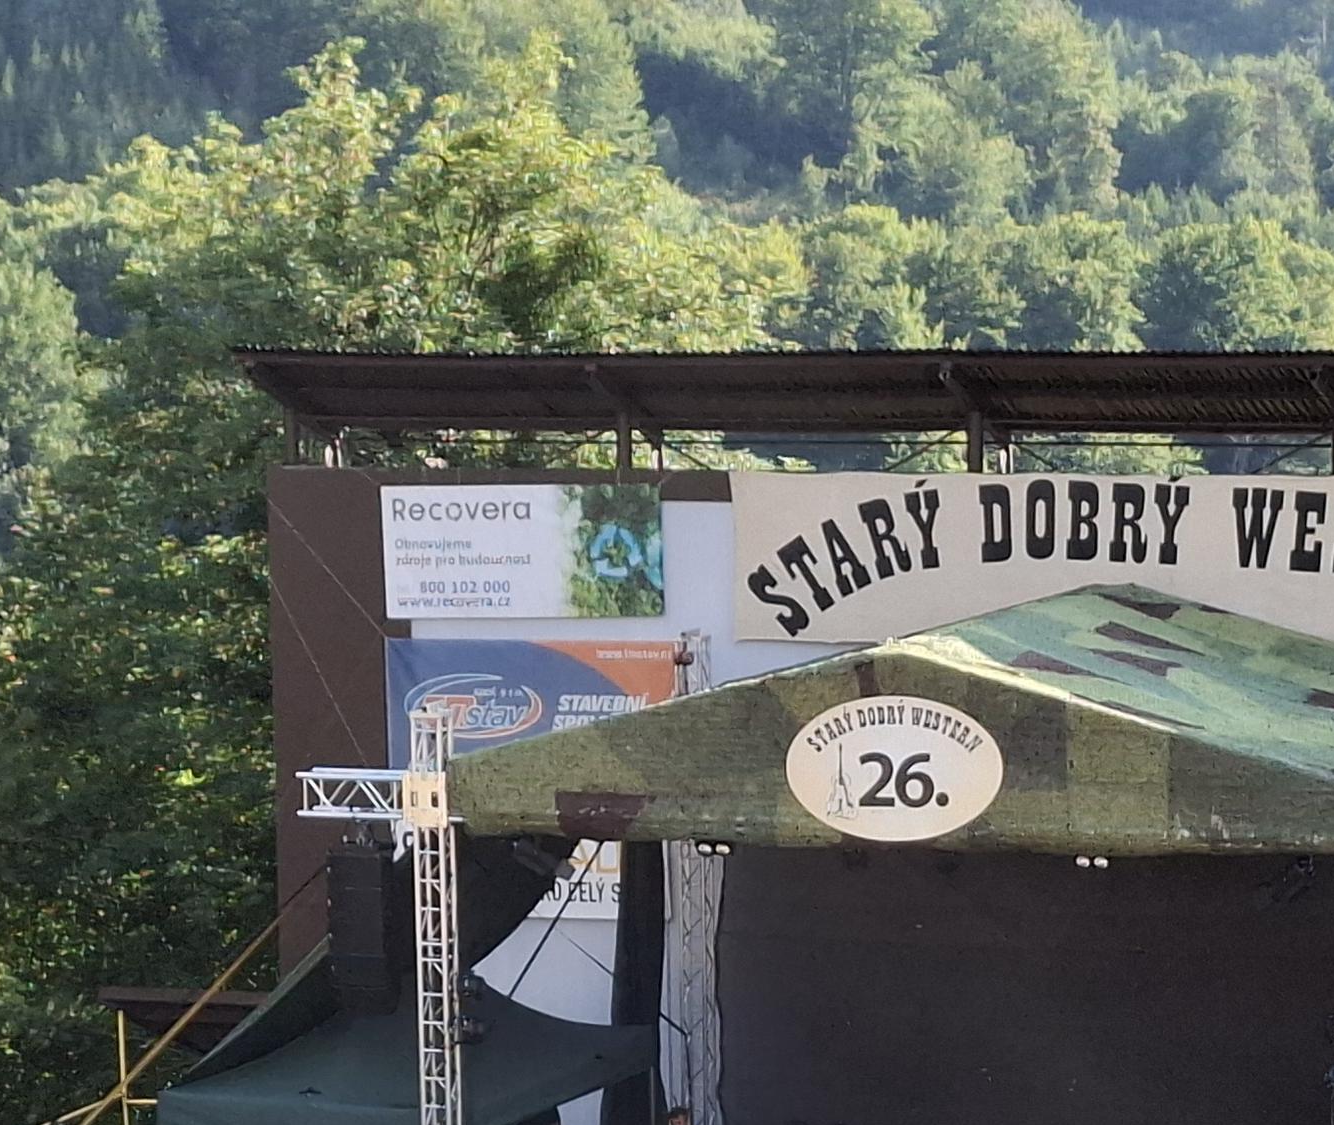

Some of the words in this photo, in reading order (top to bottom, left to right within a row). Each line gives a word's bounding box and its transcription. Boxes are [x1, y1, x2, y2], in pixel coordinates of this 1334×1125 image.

[392, 499, 531, 522] Recovera
[748, 478, 942, 637] STARÝ
[978, 476, 1190, 565] DOBRÝ
[420, 581, 445, 594] 800
[452, 581, 478, 594] 102
[483, 580, 510, 593] 000
[557, 692, 649, 713] STAVEBNÍ
[806, 708, 854, 752] STARÝ
[856, 699, 905, 728] DOBRÝ
[911, 706, 984, 753] WESTERN
[859, 752, 949, 808] 26.
